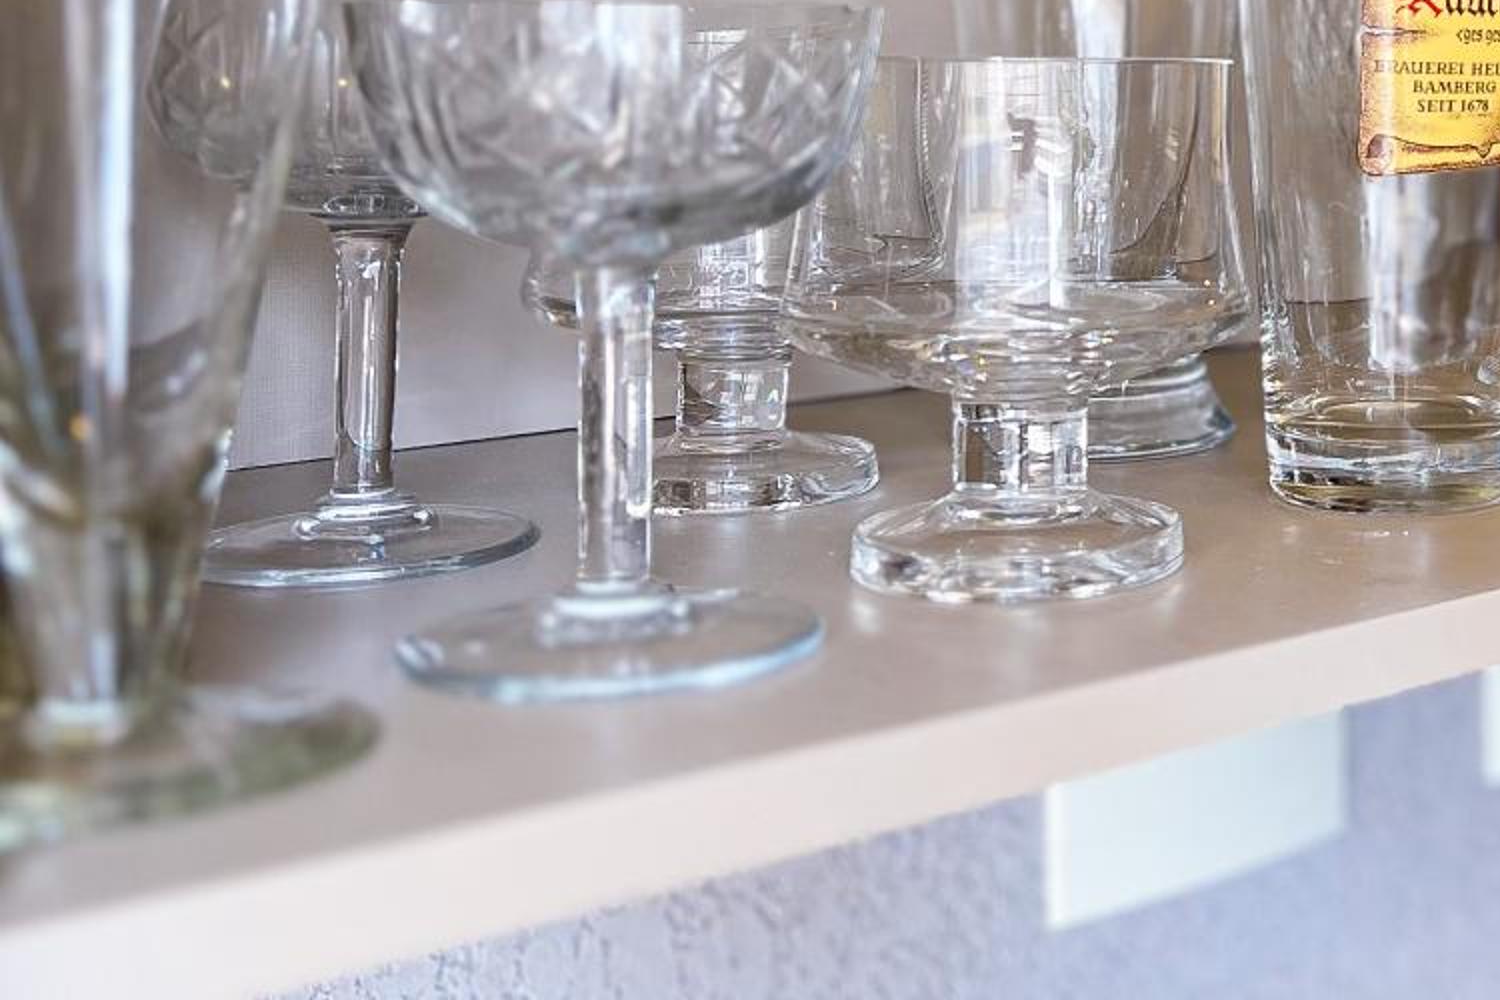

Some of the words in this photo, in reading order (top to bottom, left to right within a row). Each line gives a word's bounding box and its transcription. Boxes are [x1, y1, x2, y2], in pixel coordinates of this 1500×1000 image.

[1412, 80, 1497, 95] BAMBERG
[1417, 99, 1457, 113] SEIT
[1460, 99, 1489, 113] 1678
